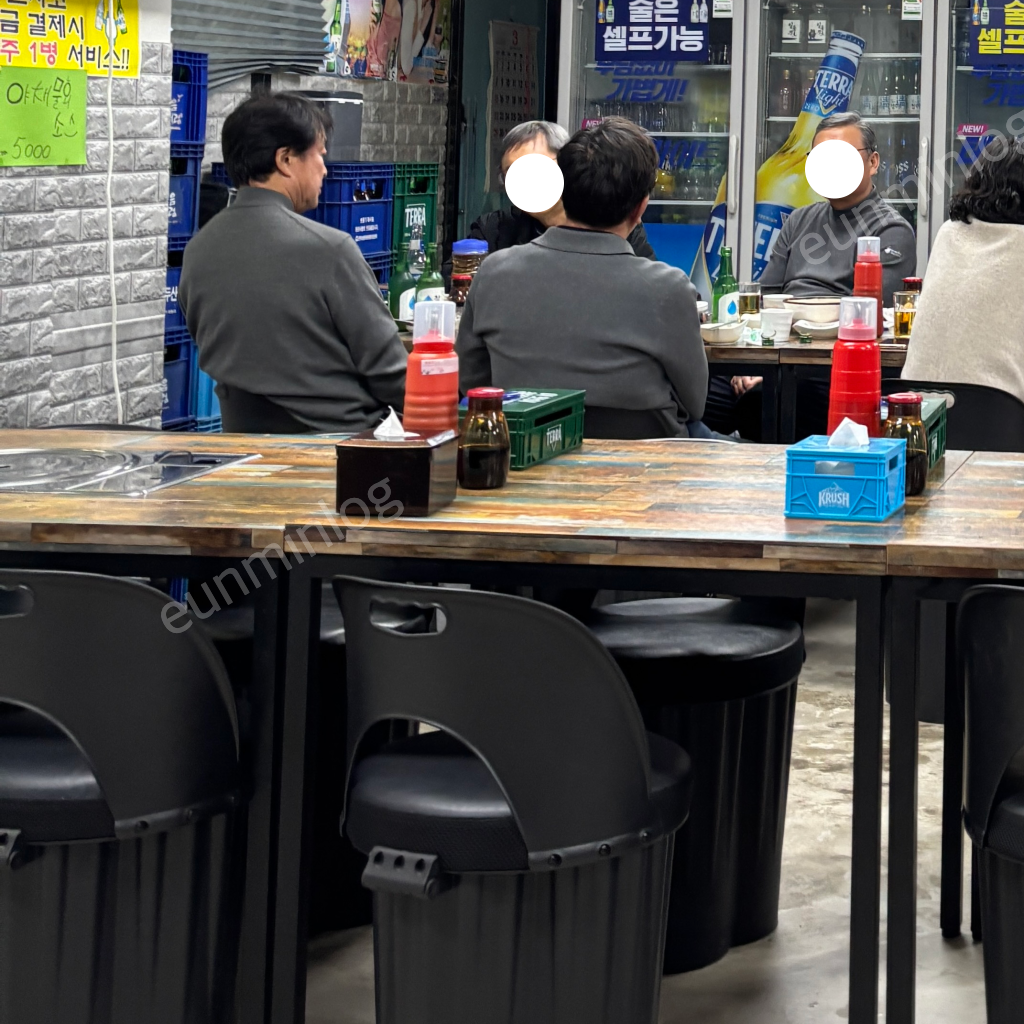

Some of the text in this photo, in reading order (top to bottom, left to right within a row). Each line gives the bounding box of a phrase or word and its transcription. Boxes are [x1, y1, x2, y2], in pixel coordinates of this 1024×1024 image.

[0, 9, 85, 40] 금 결제시
[603, 25, 704, 52] 셀프가능
[29, 42, 58, 66] 1병
[68, 44, 130, 70] 서비스!!
[813, 70, 854, 96] TERRA
[816, 88, 846, 107] Light
[962, 125, 984, 133] NEW!
[12, 136, 52, 159] 5000
[547, 428, 562, 446] TERRA
[818, 489, 850, 508] KRUSH
